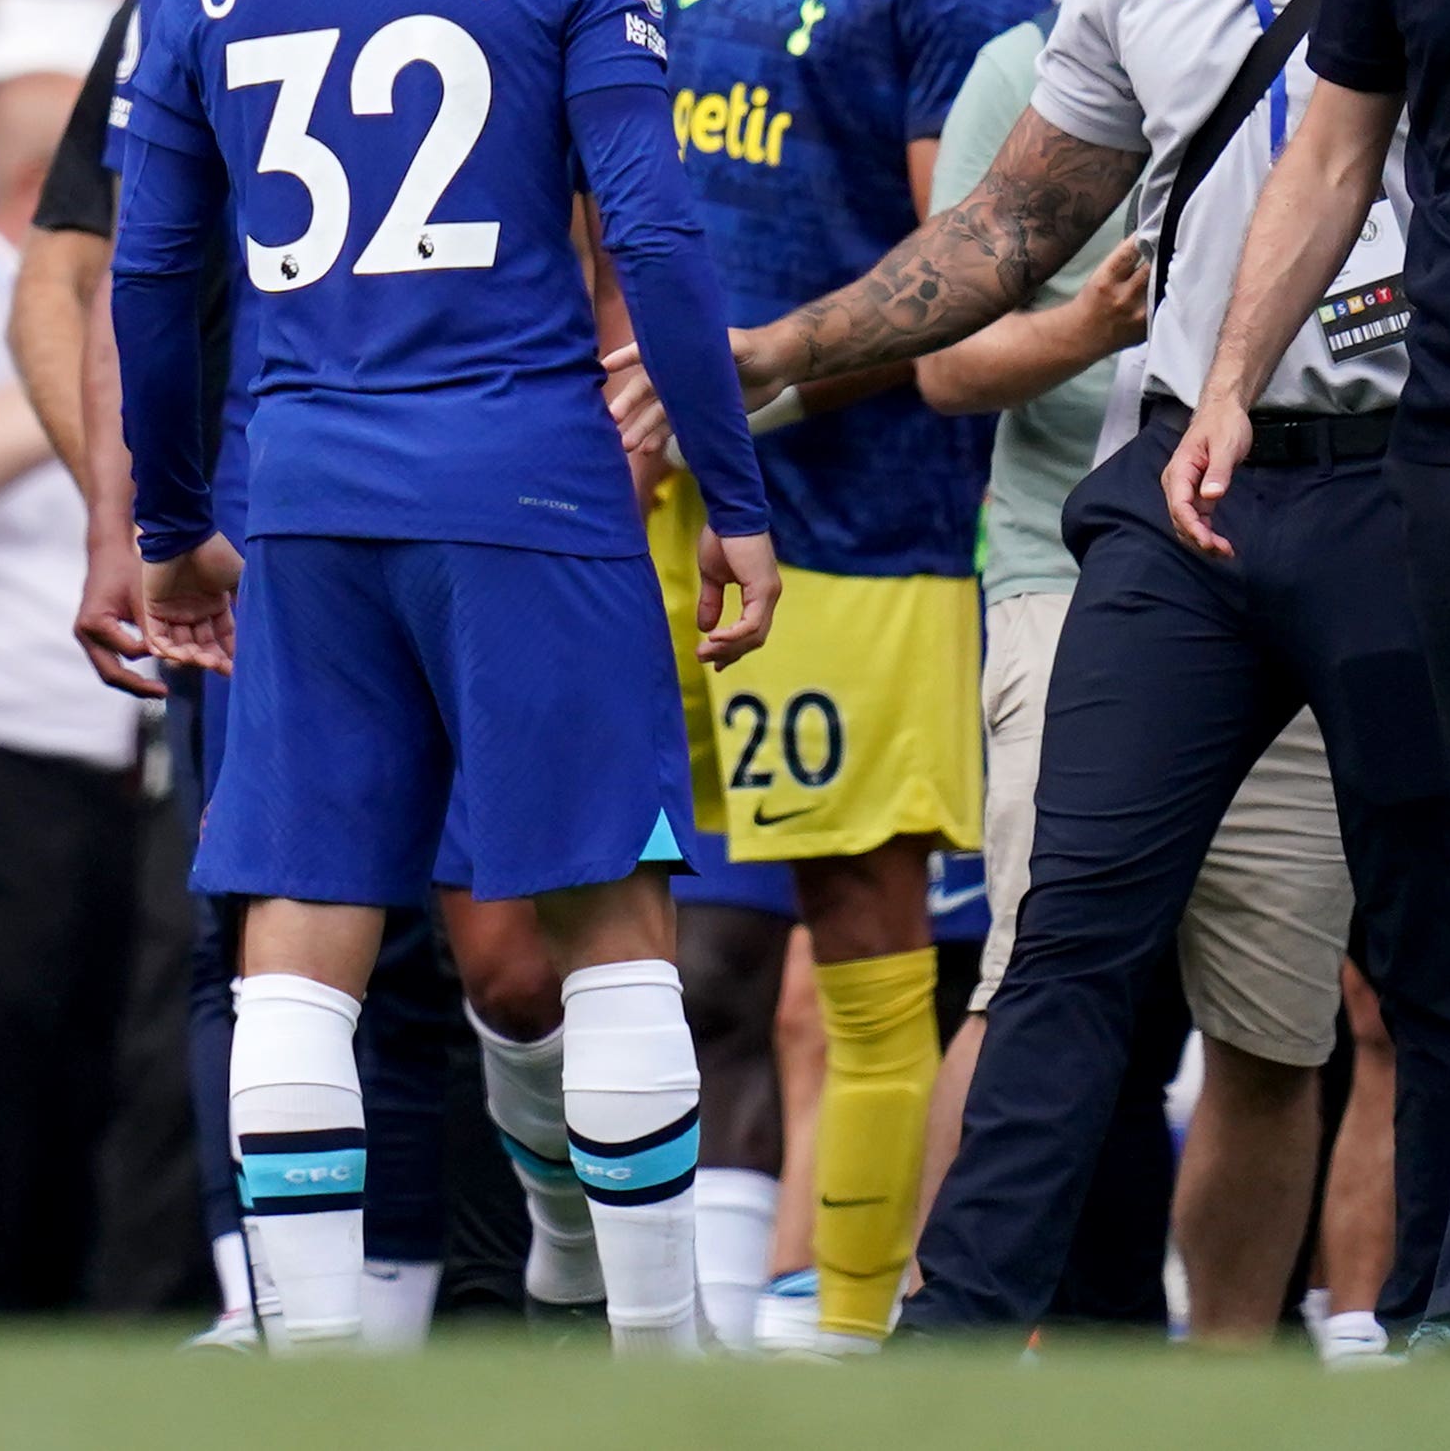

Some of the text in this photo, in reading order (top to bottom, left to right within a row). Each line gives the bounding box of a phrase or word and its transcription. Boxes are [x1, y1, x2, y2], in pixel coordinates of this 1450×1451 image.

[225, 14, 501, 292] 32
[673, 81, 793, 167] getir
[723, 690, 845, 790] 20
